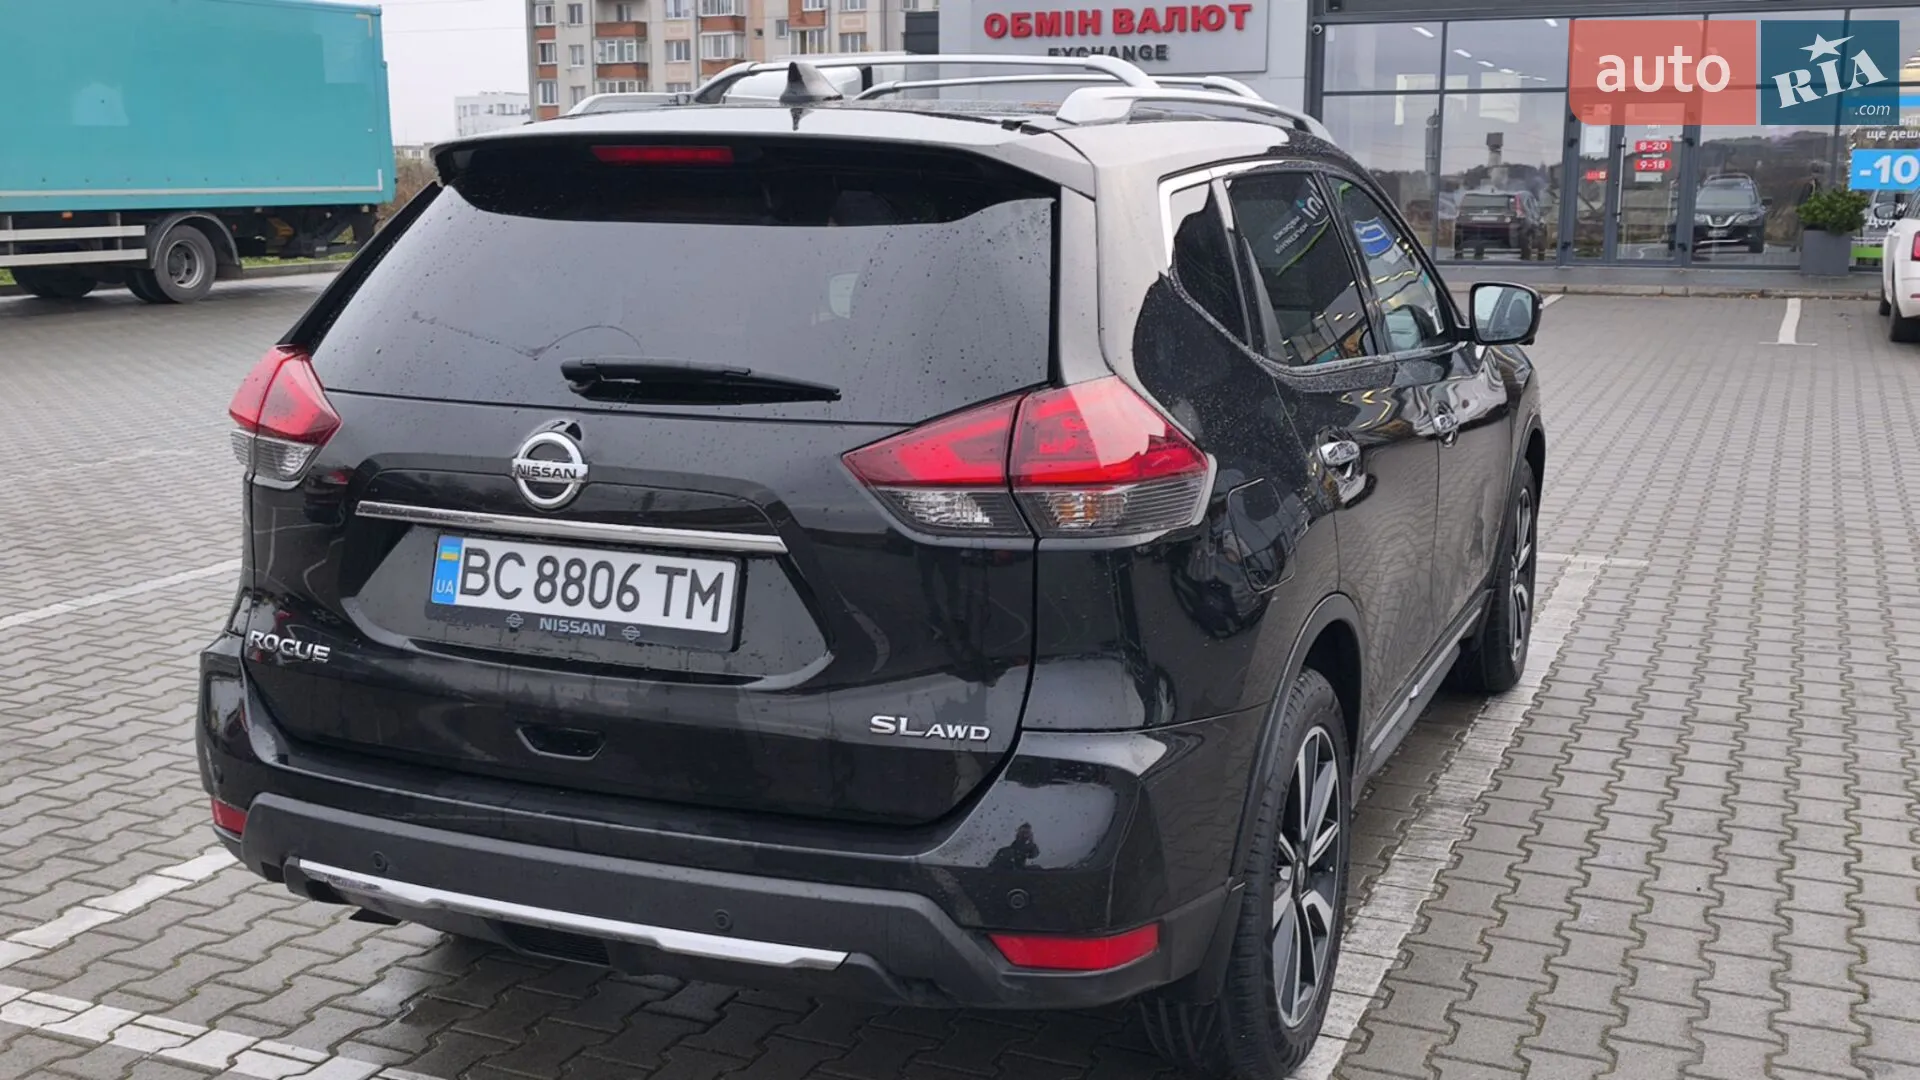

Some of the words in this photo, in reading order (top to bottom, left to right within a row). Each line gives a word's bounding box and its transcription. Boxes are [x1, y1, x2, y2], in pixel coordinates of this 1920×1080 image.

[984, 14, 1101, 39] ОБМІН
[1112, 4, 1252, 34] ВАЛЮТ
[1639, 142, 1668, 151] 8-20
[1639, 160, 1665, 169] 9-18
[516, 464, 578, 479] NISSAN
[436, 580, 454, 595] UA
[460, 547, 526, 600] BC
[533, 555, 642, 612] 8806
[655, 565, 724, 622] TM
[539, 617, 606, 637] NISSAN
[248, 630, 331, 663] ROGUE
[869, 715, 925, 736] SL
[925, 723, 991, 740] AWD
